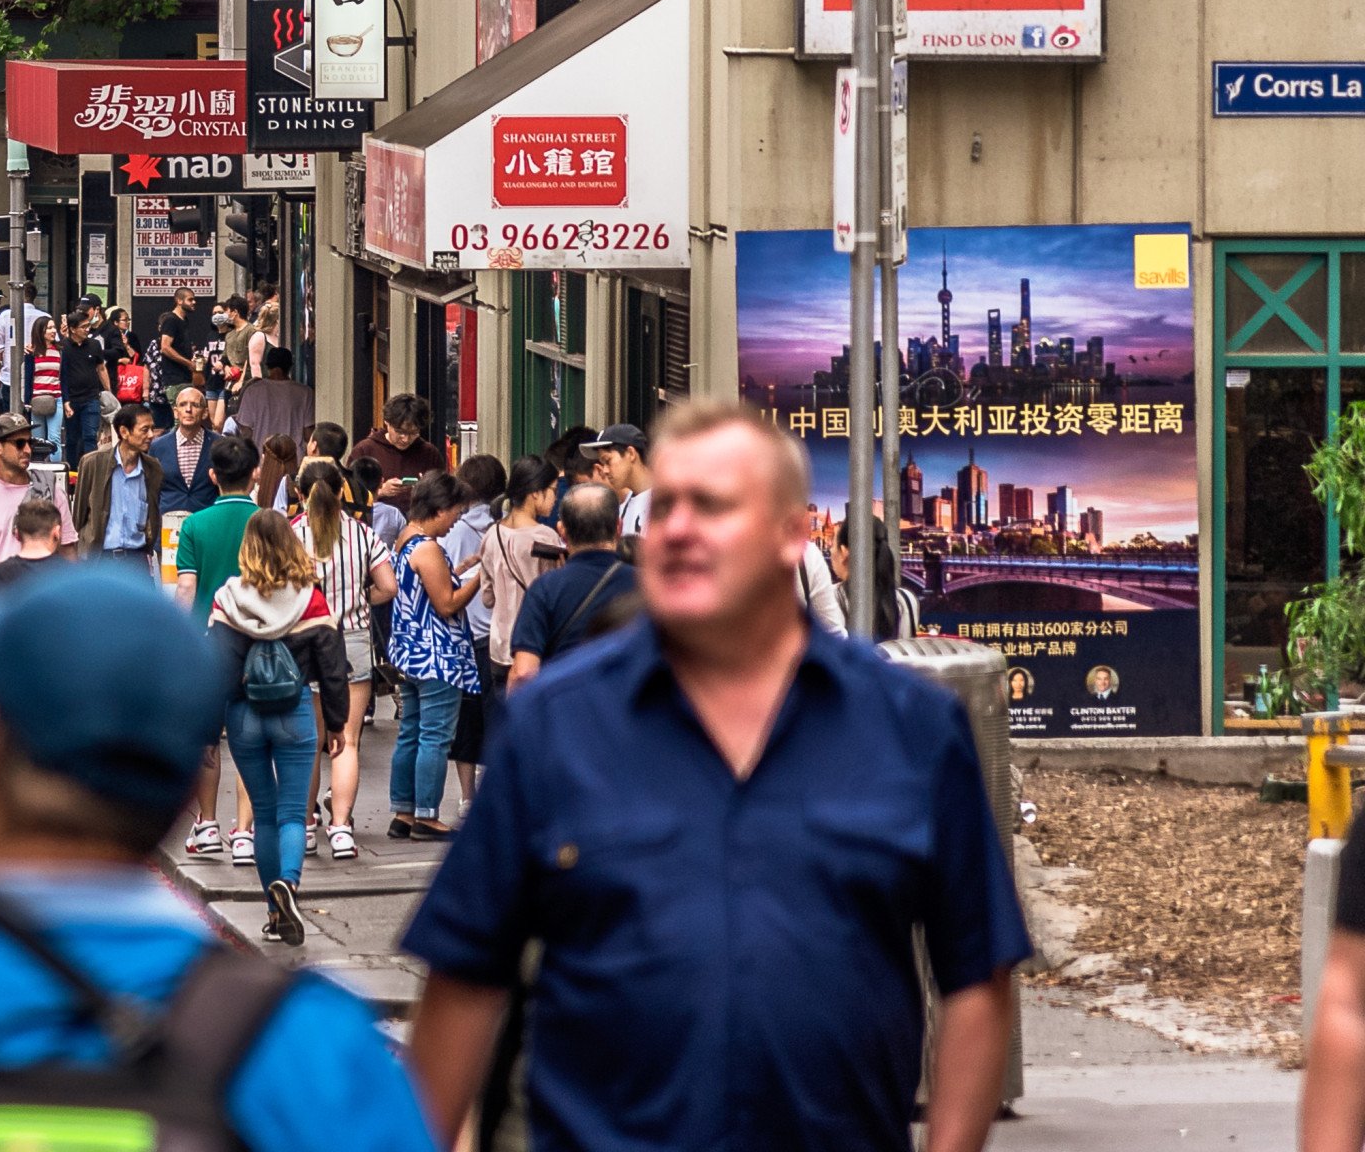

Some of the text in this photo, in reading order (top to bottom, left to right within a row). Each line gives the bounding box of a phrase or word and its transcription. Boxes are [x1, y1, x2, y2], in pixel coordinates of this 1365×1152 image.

[922, 33, 1017, 48] FIND US ON
[323, 65, 376, 73] GRANDMA
[1253, 73, 1362, 98] Corrs La
[178, 118, 247, 137] CRYSTAL
[268, 118, 355, 130] DINING
[502, 132, 617, 144] SHANGHAI STREET
[167, 154, 233, 179] nab
[503, 147, 615, 176] 小籠館
[251, 170, 311, 178] SHOU SUMIYAKI
[136, 232, 151, 245] THE
[154, 232, 186, 245] EXFORD
[451, 223, 669, 251] 03 9662 3226
[135, 278, 213, 287] FREE ENTRY
[1138, 269, 1187, 285] savills
